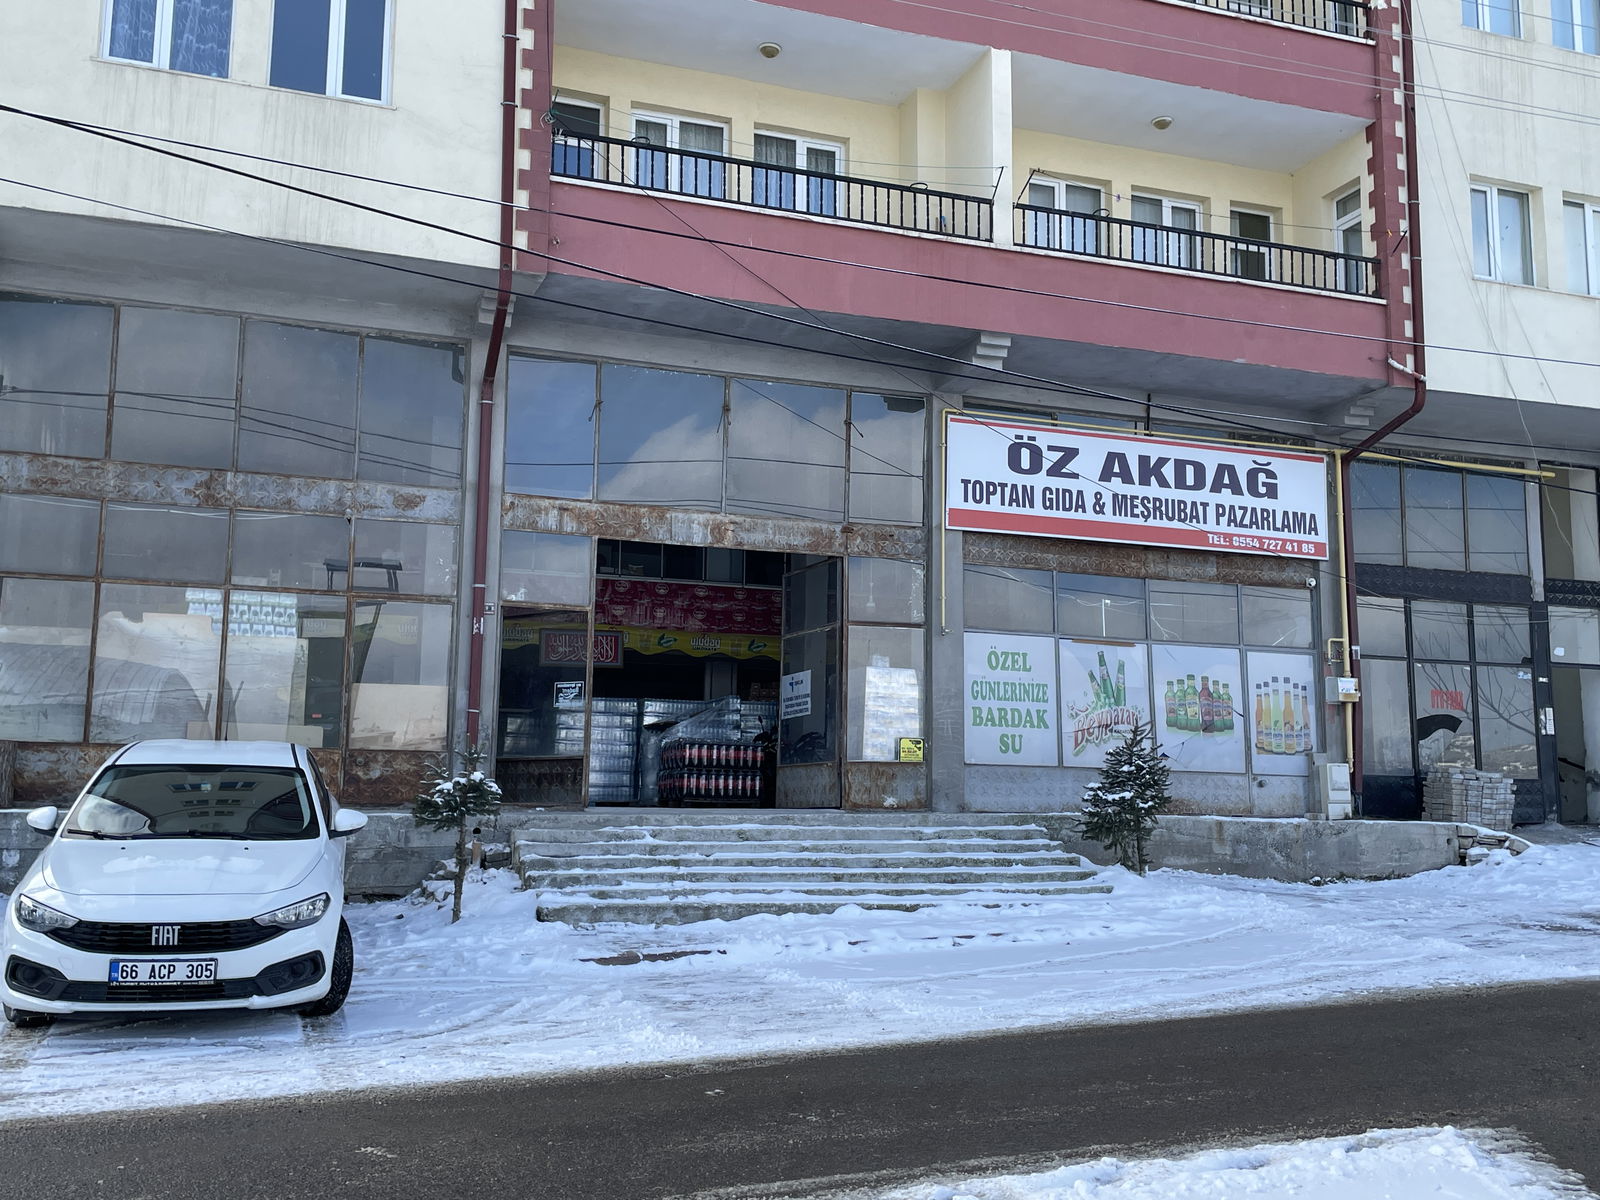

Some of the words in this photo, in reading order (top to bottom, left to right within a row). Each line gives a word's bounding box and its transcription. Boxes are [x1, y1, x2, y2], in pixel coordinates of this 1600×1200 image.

[1007, 434, 1080, 480] ÖZ
[1098, 451, 1278, 500] AKDAĞ
[960, 478, 1036, 510] TOPTAN
[1042, 486, 1087, 515] GIDA
[1092, 493, 1106, 516] &
[1112, 493, 1210, 526] MEŞRUBAT
[1215, 503, 1319, 536] PAZARLAMA
[1207, 533, 1230, 546] TEL:
[1232, 535, 1260, 549] 0554
[1262, 538, 1283, 551] 727
[1286, 540, 1298, 552] 41
[1301, 542, 1315, 554] 85
[987, 646, 1032, 673] ÖZEL
[970, 676, 1049, 704] GÜNLERİNİZE
[972, 706, 1049, 730] BARDAK
[1000, 733, 1023, 754] SU
[151, 925, 181, 946] FIAT
[120, 964, 139, 980] 66
[148, 964, 176, 980] ACP
[185, 963, 213, 979] 305
